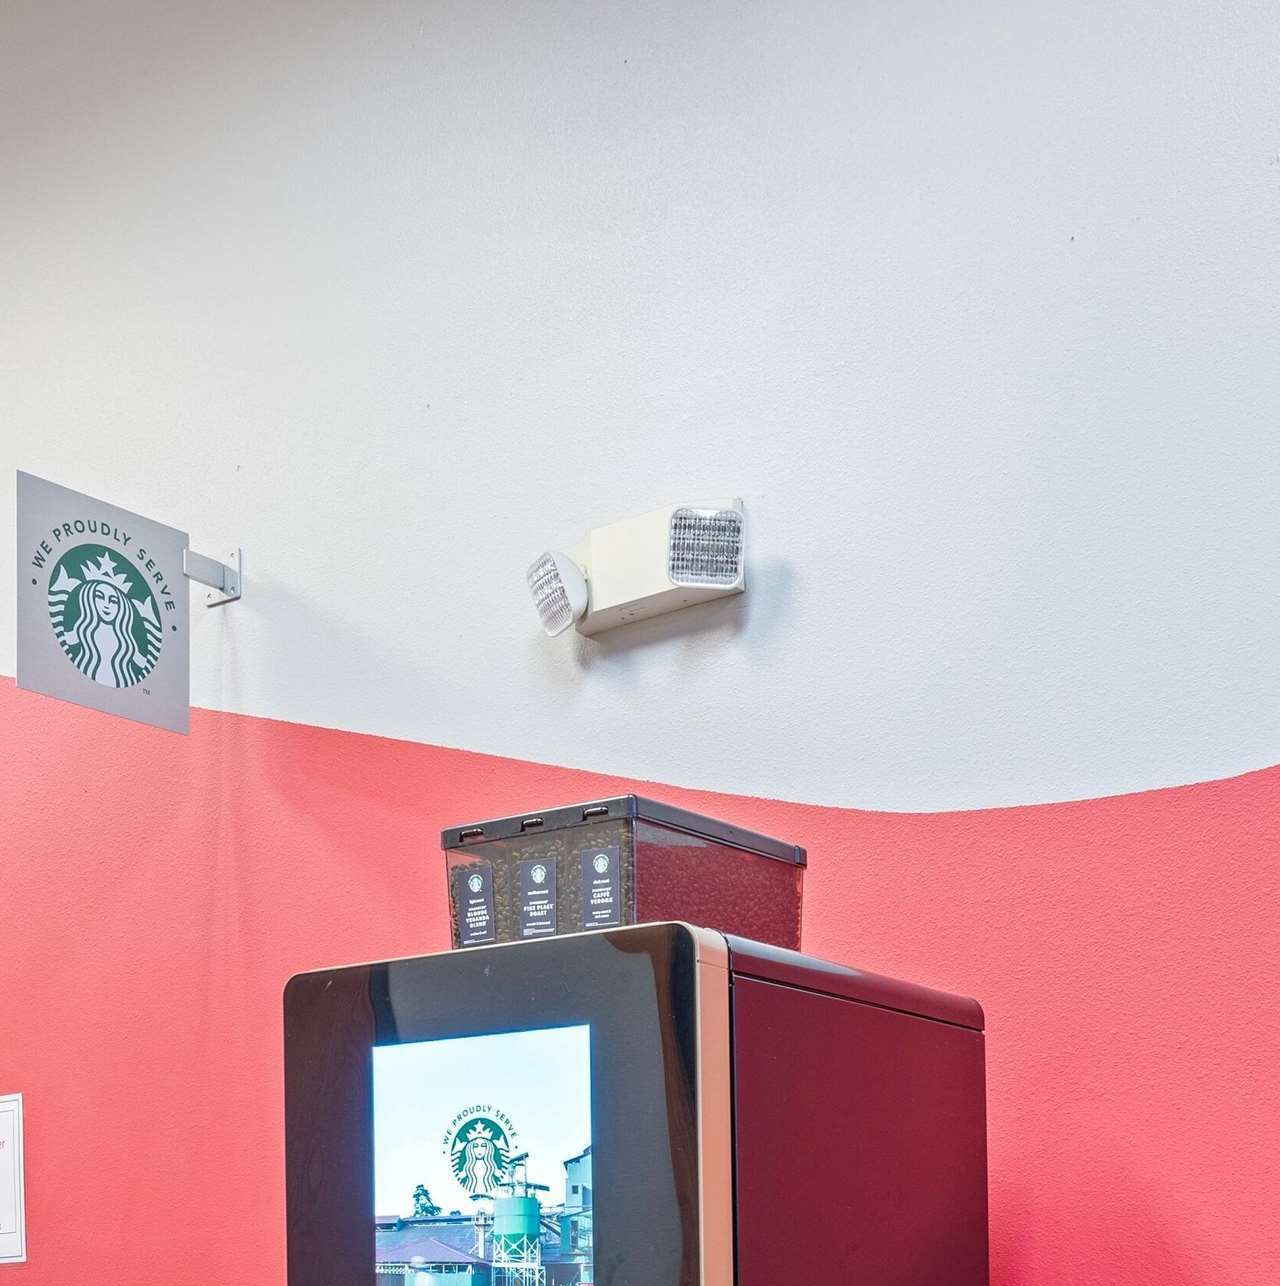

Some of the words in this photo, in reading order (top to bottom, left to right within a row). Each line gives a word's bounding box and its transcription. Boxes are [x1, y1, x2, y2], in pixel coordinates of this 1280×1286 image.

[31, 540, 53, 570] WE
[52, 519, 132, 547] PROUDLY
[137, 548, 177, 612] SERVE
[443, 1130, 453, 1145] WE
[452, 1105, 493, 1127] PROUDLY
[495, 1110, 518, 1138] SERVE
